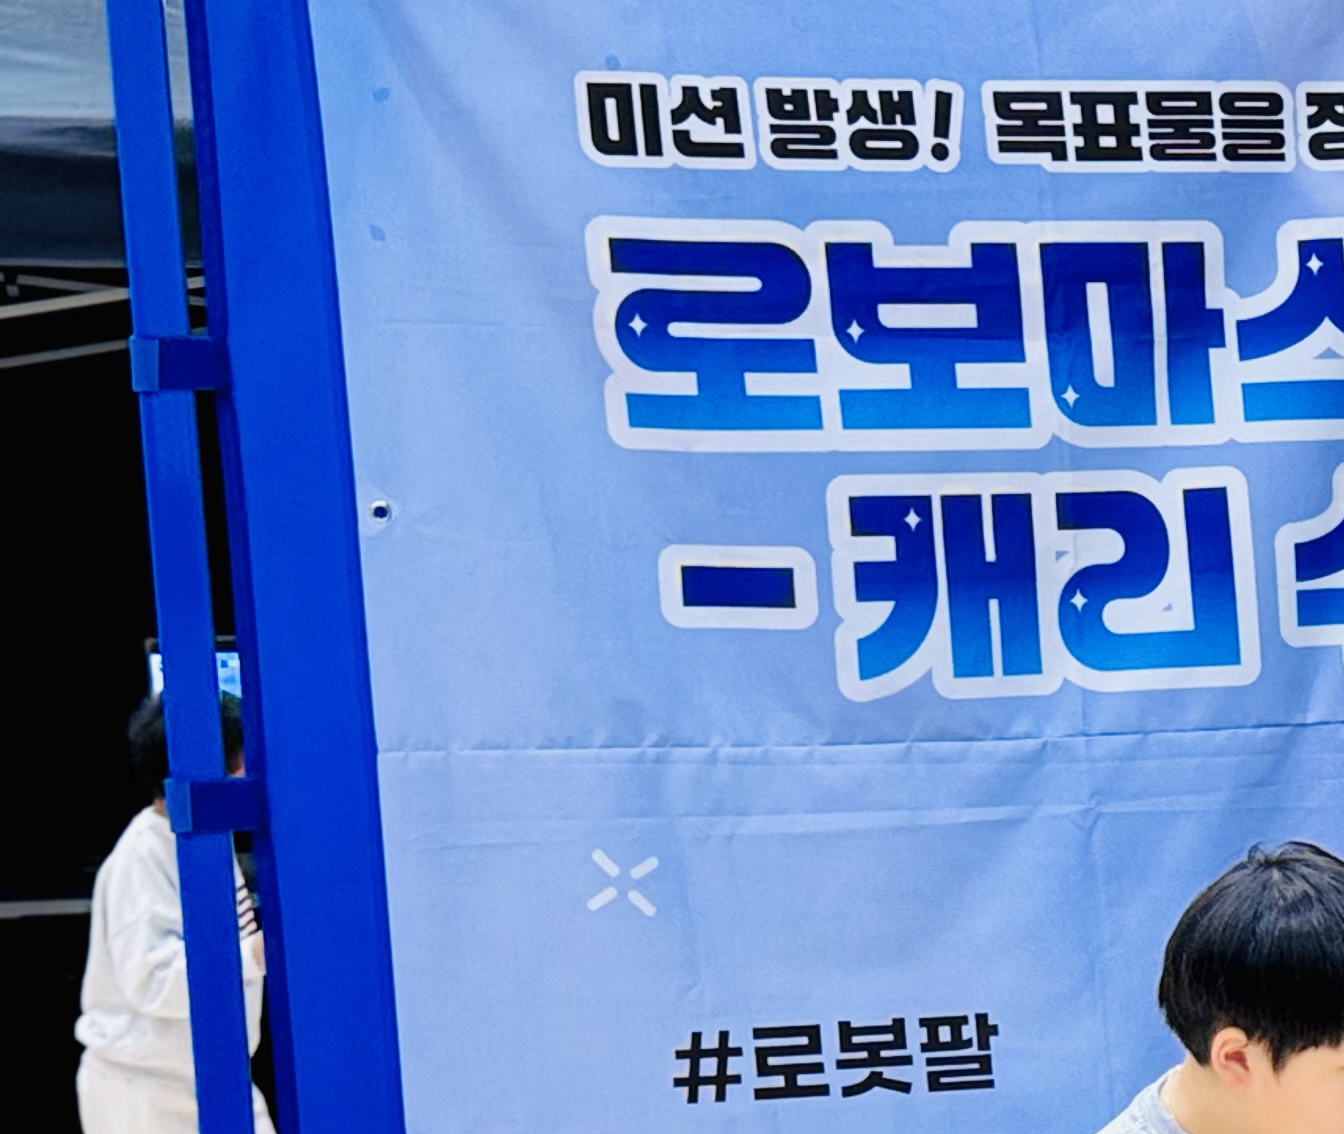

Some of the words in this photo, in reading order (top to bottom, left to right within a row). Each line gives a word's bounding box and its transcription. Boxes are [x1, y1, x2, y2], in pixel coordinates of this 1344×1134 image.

[586, 82, 746, 160] 미션
[766, 87, 953, 162] 발생!
[992, 90, 1287, 162] 목표물을
[848, 486, 1243, 682] 캐리
[672, 1012, 999, 1105] #로봇팔
